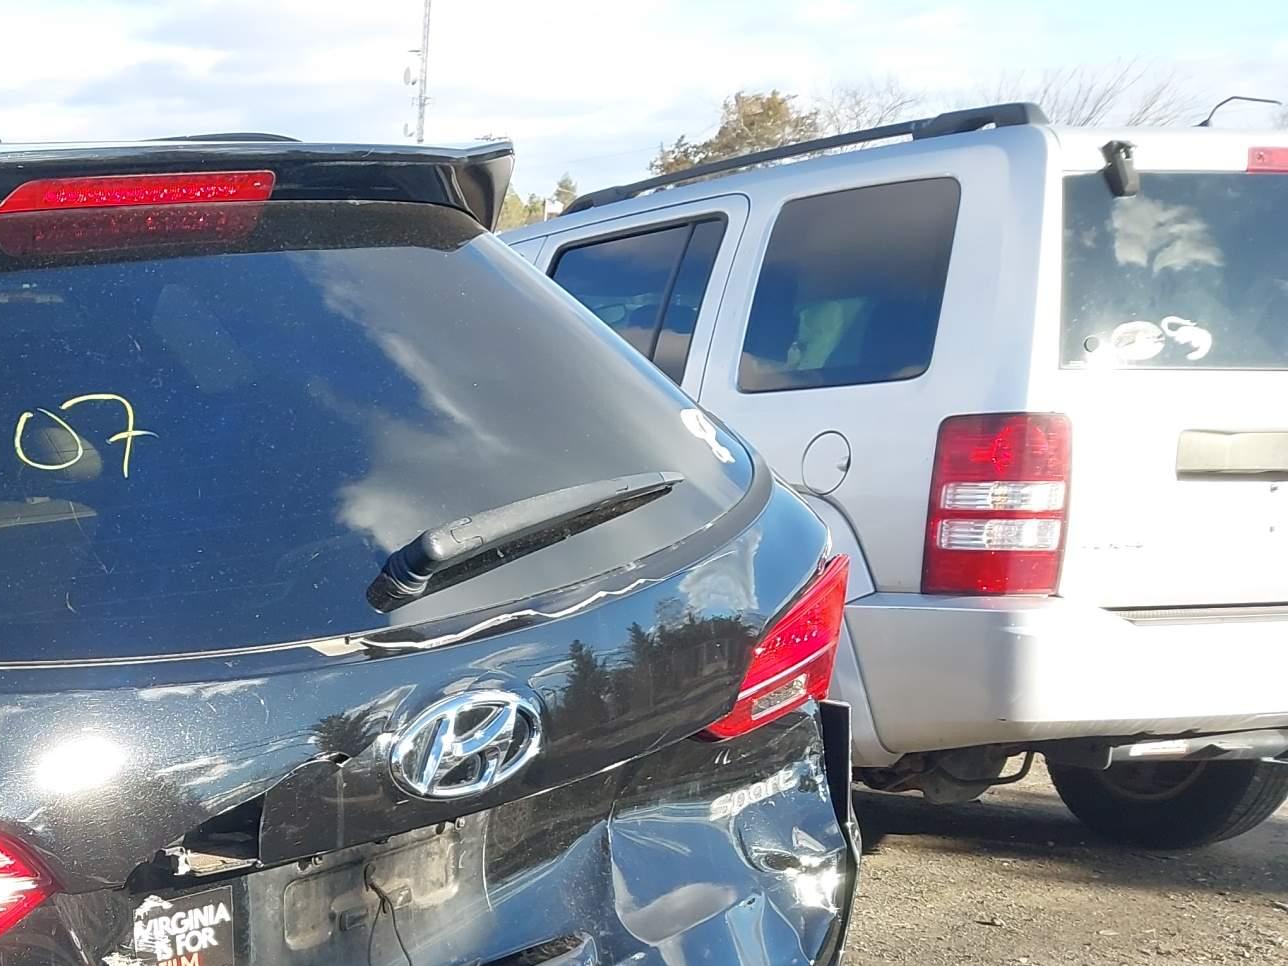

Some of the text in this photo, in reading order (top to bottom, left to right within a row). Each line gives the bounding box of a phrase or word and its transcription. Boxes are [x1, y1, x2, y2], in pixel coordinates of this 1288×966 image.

[133, 902, 232, 937] VIRGINIA
[155, 926, 219, 961] IS FOR
